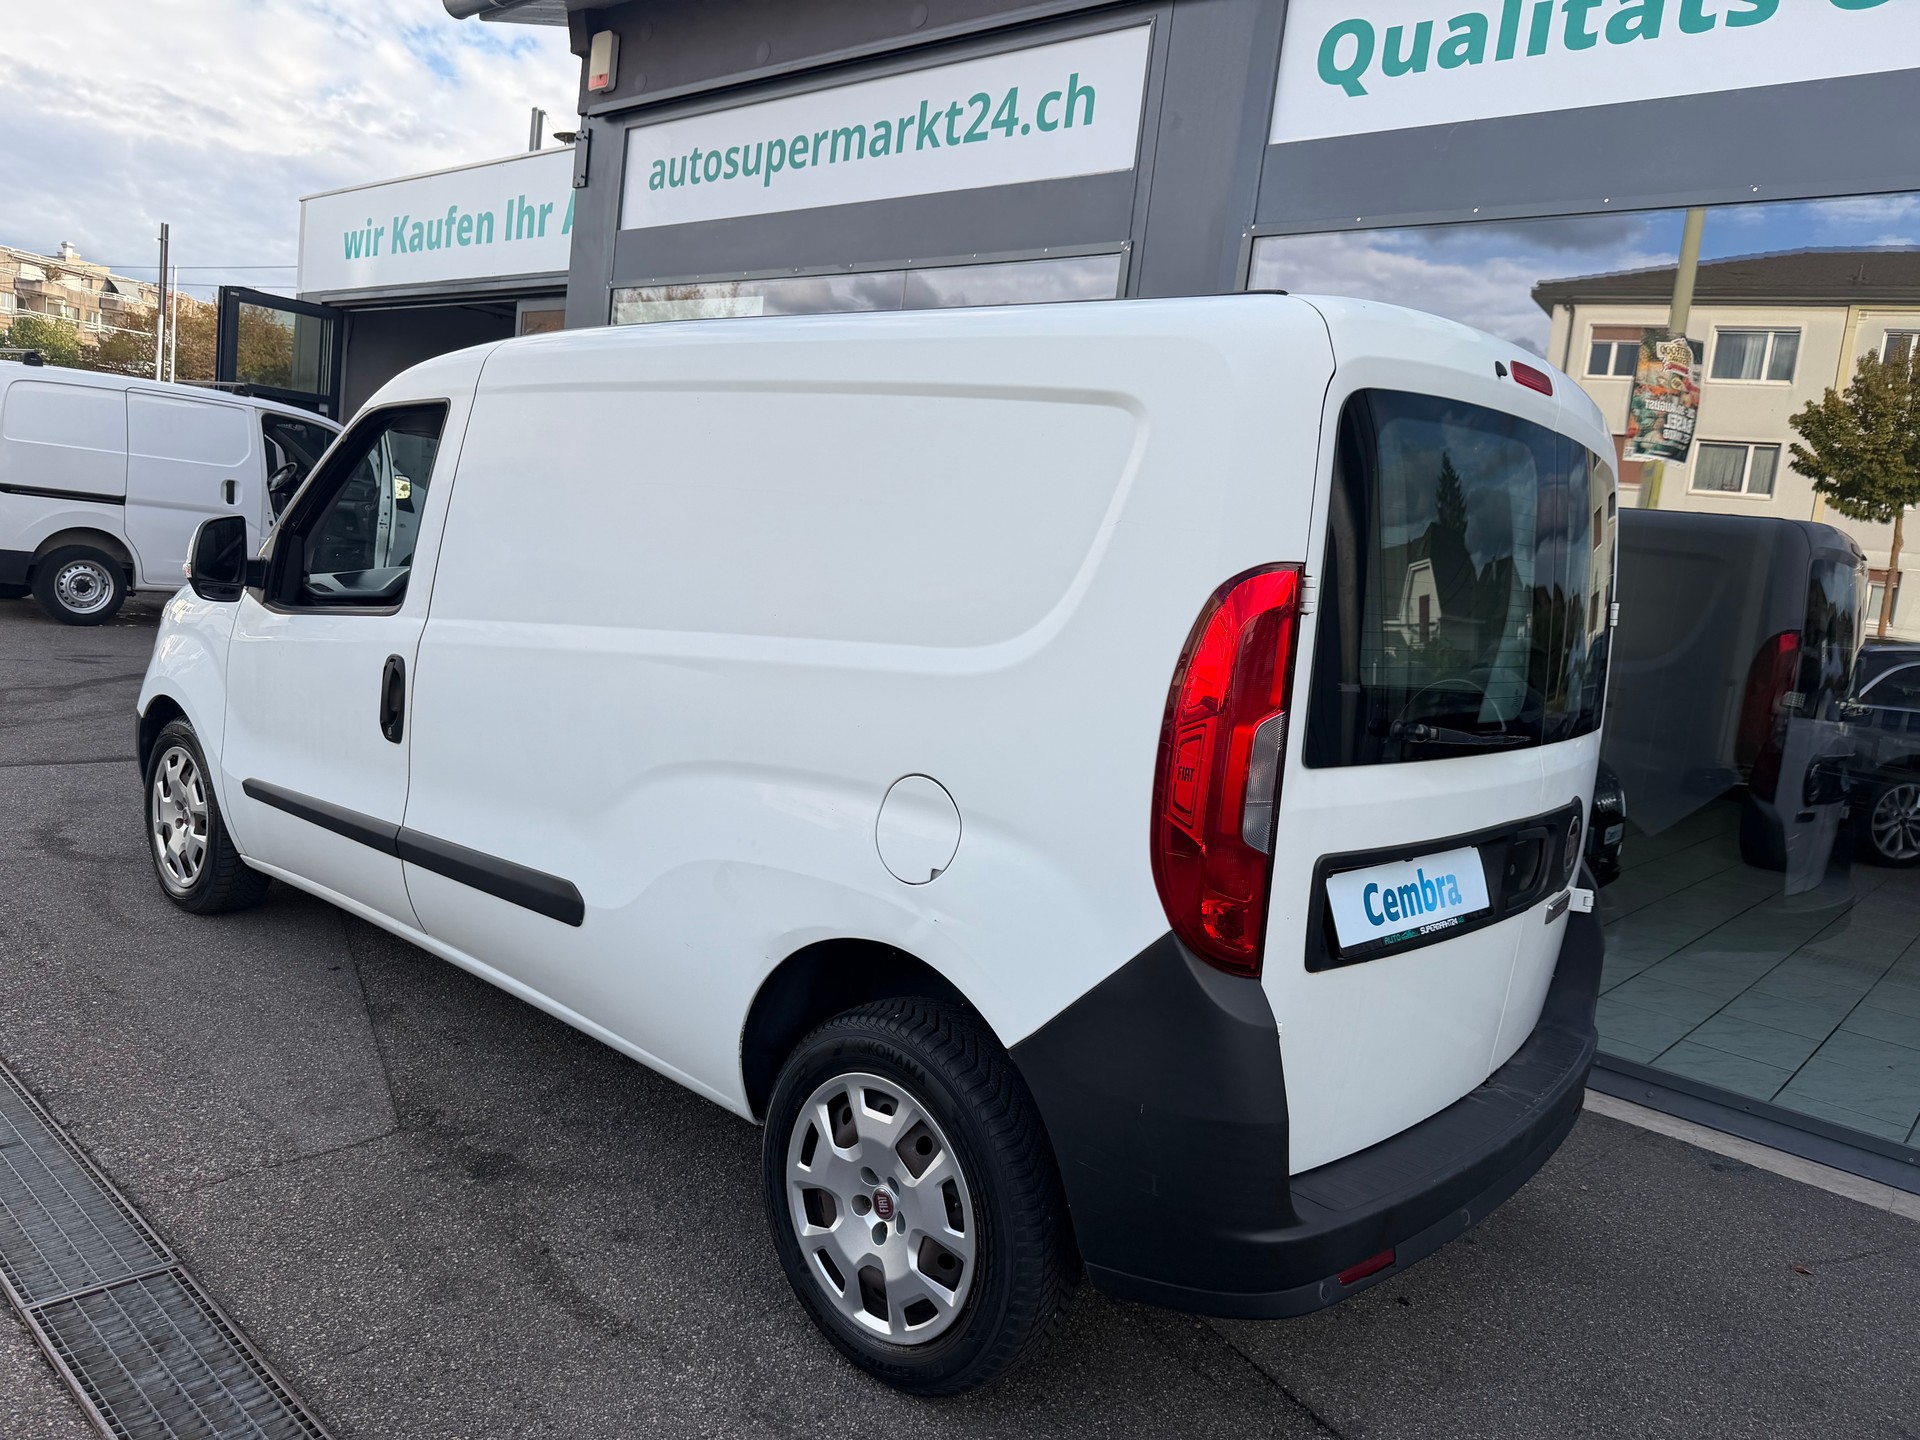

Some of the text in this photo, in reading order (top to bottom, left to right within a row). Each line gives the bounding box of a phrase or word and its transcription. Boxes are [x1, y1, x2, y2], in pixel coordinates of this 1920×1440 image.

[649, 73, 1096, 191] autosupermarkt24.ch
[344, 217, 385, 260] wir
[391, 205, 494, 254] Kaufen
[505, 195, 553, 241] Ihr
[1177, 765, 1195, 783] FIAT
[1363, 867, 1462, 927] Cembra
[1384, 933, 1401, 945] AUTO
[877, 1194, 889, 1214] FIAT
